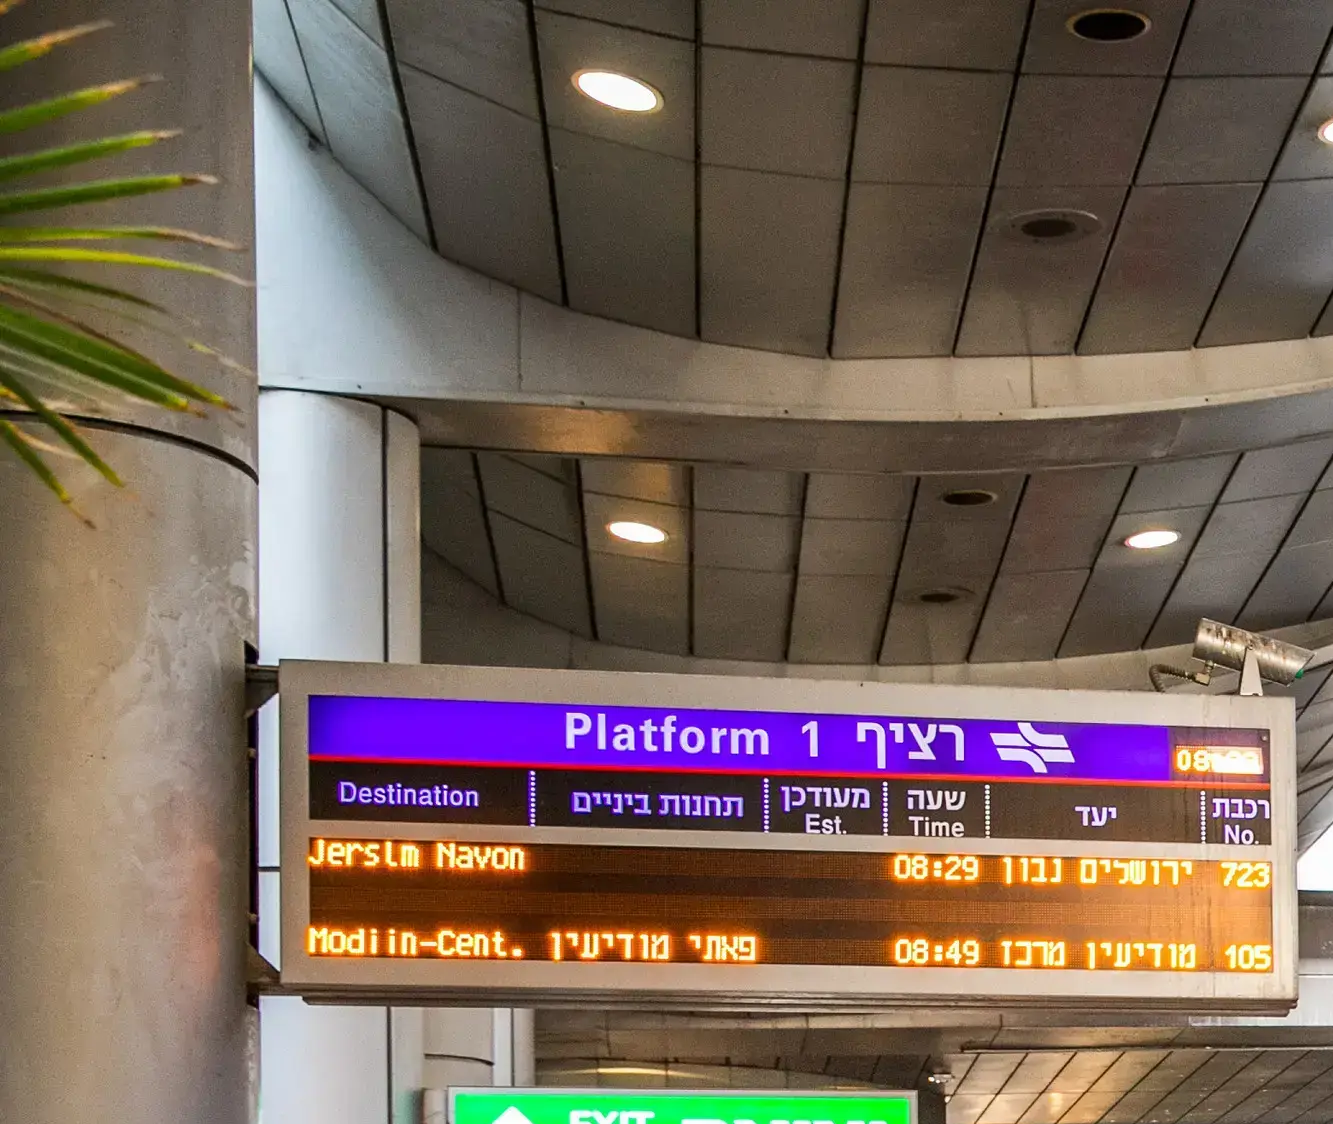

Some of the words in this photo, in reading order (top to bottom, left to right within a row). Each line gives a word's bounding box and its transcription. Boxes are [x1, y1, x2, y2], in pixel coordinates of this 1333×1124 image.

[565, 711, 770, 755] Platform
[800, 720, 820, 758] 1
[857, 721, 966, 769] רציף
[339, 781, 480, 807] Destination
[571, 790, 651, 816] ביניים
[658, 791, 744, 818] תחנות
[780, 785, 871, 813] מעודכן
[907, 787, 967, 811] שעה
[1075, 806, 1118, 827] יעד
[1211, 797, 1271, 820] רכבת
[805, 816, 848, 835] Est.
[908, 816, 965, 838] Time
[1224, 825, 1260, 845] No.
[308, 838, 420, 869] Jerslm
[436, 842, 526, 871] Navon
[893, 854, 980, 881] 08:29
[1003, 857, 1063, 884] נבון
[1080, 858, 1193, 885] ירושלים
[1220, 861, 1271, 888] 723
[308, 926, 526, 958] Modiin-Cent.
[551, 931, 671, 962] מודיעין
[688, 934, 757, 962] פאתי
[894, 938, 980, 966] 08:49
[1000, 940, 1066, 967] מרכז
[1086, 942, 1197, 969] מודיעין
[1224, 943, 1272, 970] 105
